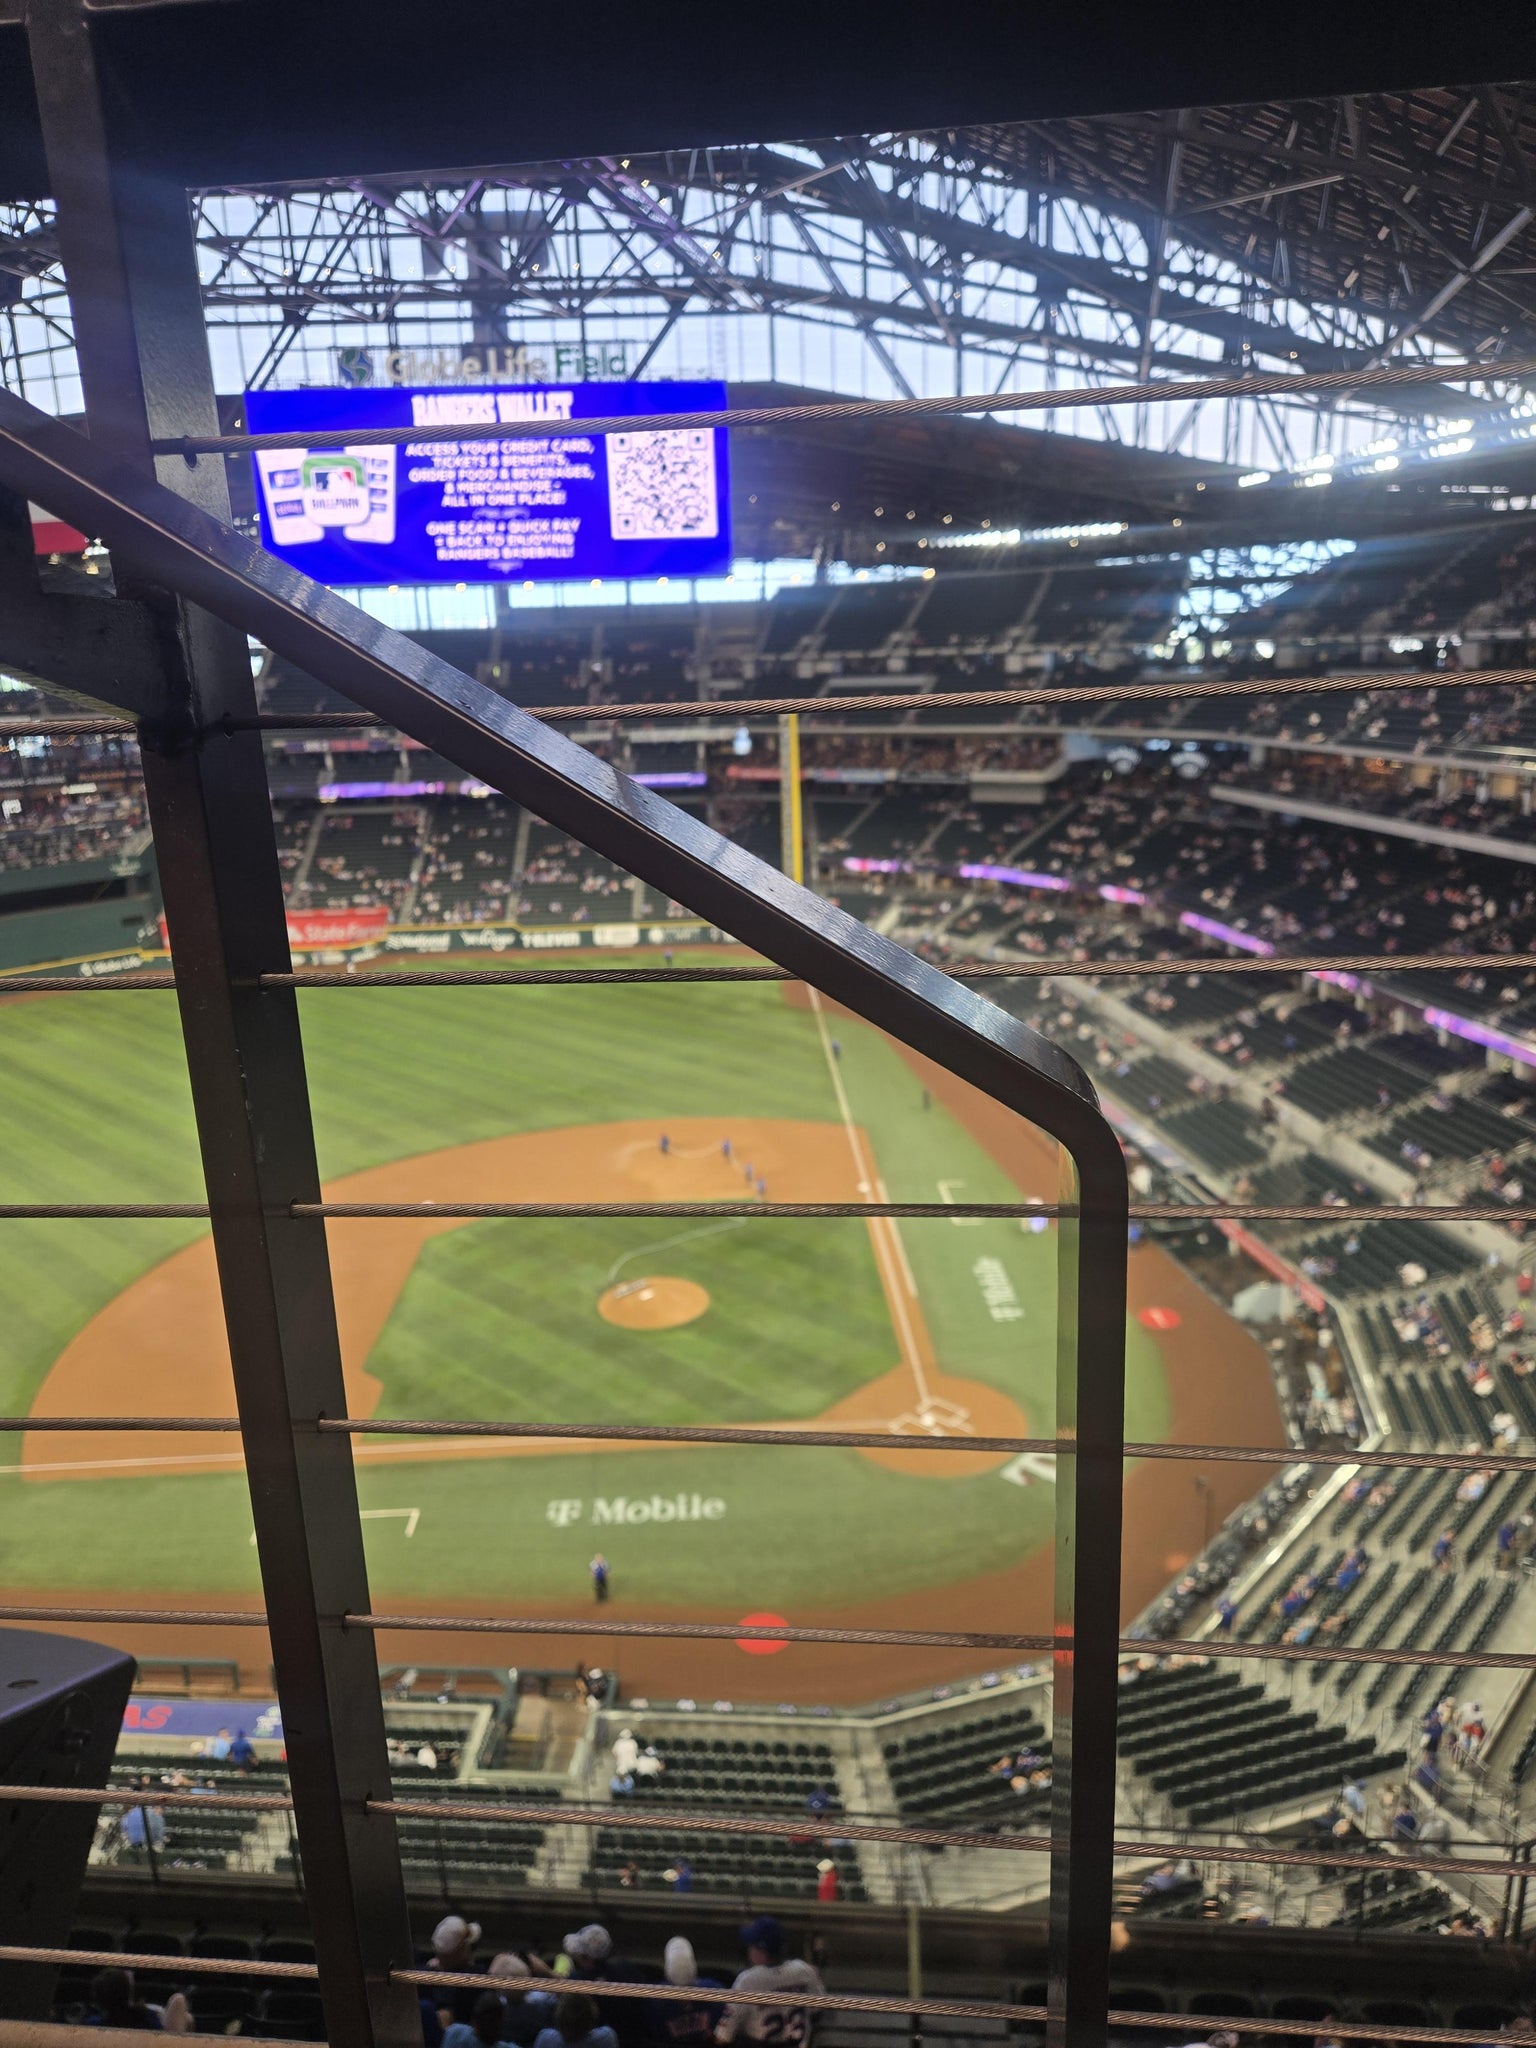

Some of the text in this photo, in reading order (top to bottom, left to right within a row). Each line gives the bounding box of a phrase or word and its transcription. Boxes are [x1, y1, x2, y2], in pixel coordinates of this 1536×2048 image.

[386, 346, 627, 382] Globe Life Field
[411, 391, 574, 427] RANGERS WALLET
[405, 442, 459, 456] ACCESS
[460, 440, 499, 455] YOUR
[500, 438, 549, 454] CREDIT
[431, 455, 487, 468] TICKETS
[408, 467, 456, 482] ORDER
[458, 467, 498, 481] FOOD
[441, 494, 468, 507] ALL
[469, 493, 486, 506] IN
[486, 492, 516, 506] ONE
[426, 520, 457, 536] ONE
[457, 519, 496, 534] SCAN
[507, 518, 549, 534] QUICK
[551, 517, 581, 533] PAY
[446, 534, 484, 548] BACK
[486, 533, 504, 547] TO
[506, 533, 575, 547] ENJOYING
[436, 547, 500, 561] RANGERS
[304, 925, 345, 941] State
[591, 1493, 727, 1526] Mobile
